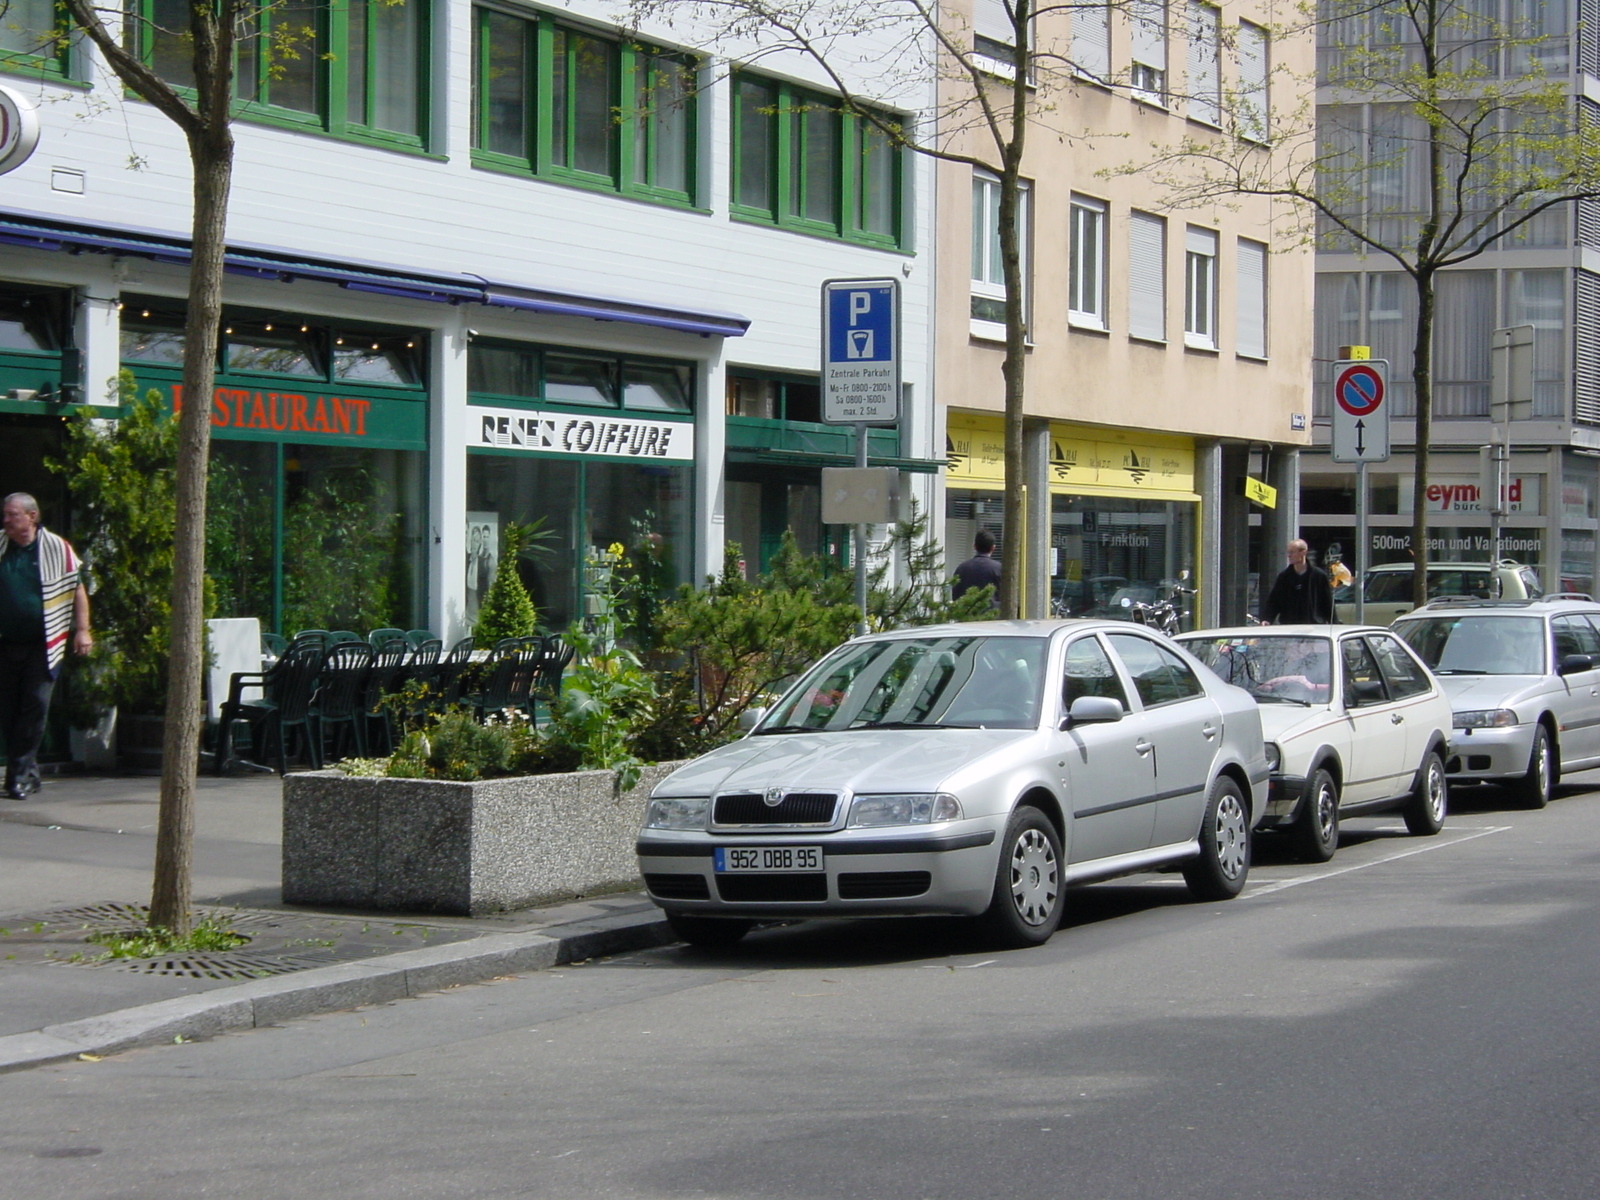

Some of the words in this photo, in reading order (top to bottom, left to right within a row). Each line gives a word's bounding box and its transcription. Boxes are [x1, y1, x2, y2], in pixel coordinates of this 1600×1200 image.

[850, 291, 871, 326] P
[830, 369, 860, 379] Zentrale
[863, 368, 891, 378] Parkuhr
[830, 384, 850, 393] Mo-Fr
[835, 395, 844, 404] Sa
[171, 385, 370, 435] STAURANT
[843, 408, 857, 416] max.
[860, 406, 865, 416] 2
[562, 419, 672, 457] COIFFURE
[1449, 536, 1471, 550] und
[730, 850, 759, 869] 952
[763, 850, 793, 868] DBB
[797, 849, 817, 868] 95
